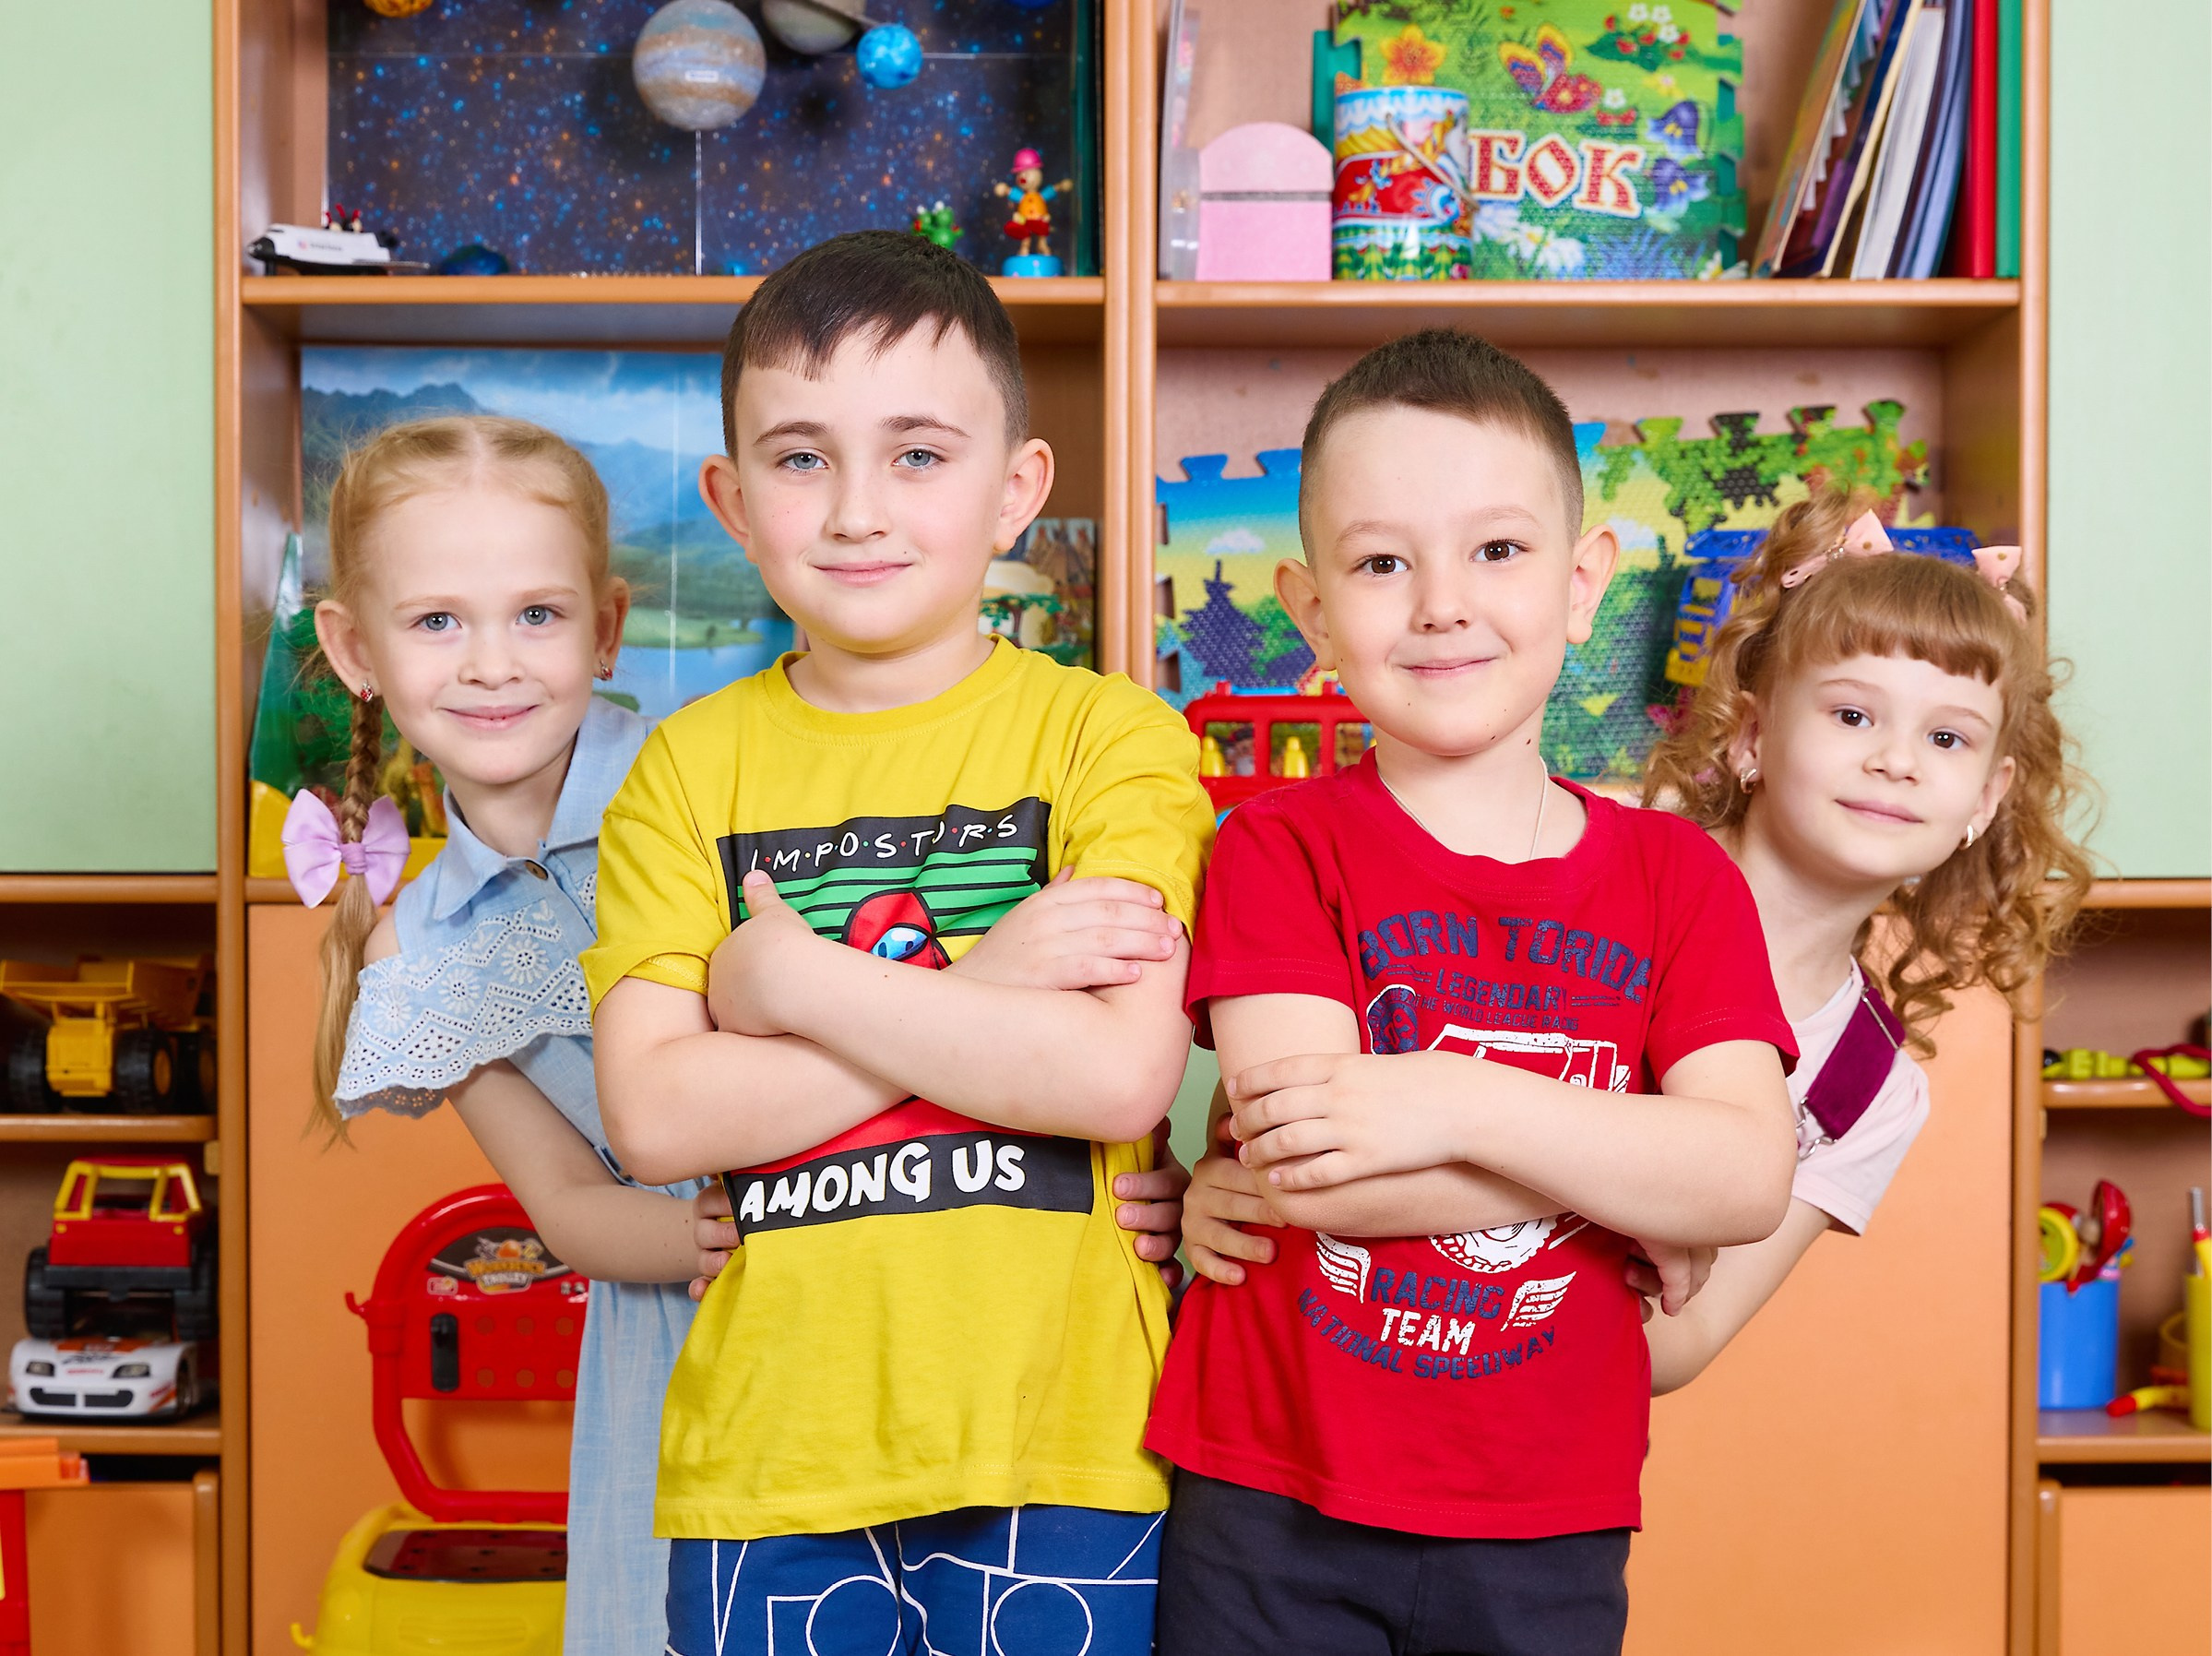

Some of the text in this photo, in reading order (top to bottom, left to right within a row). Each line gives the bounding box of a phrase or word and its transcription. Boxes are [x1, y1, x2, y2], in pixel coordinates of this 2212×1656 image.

[1358, 910, 1479, 980] BORN
[740, 1139, 1026, 1223] AMONG US
[1371, 1267, 1505, 1320] RACING
[1297, 1287, 1403, 1374] NATIONAL
[1380, 1307, 1476, 1356] TEAM
